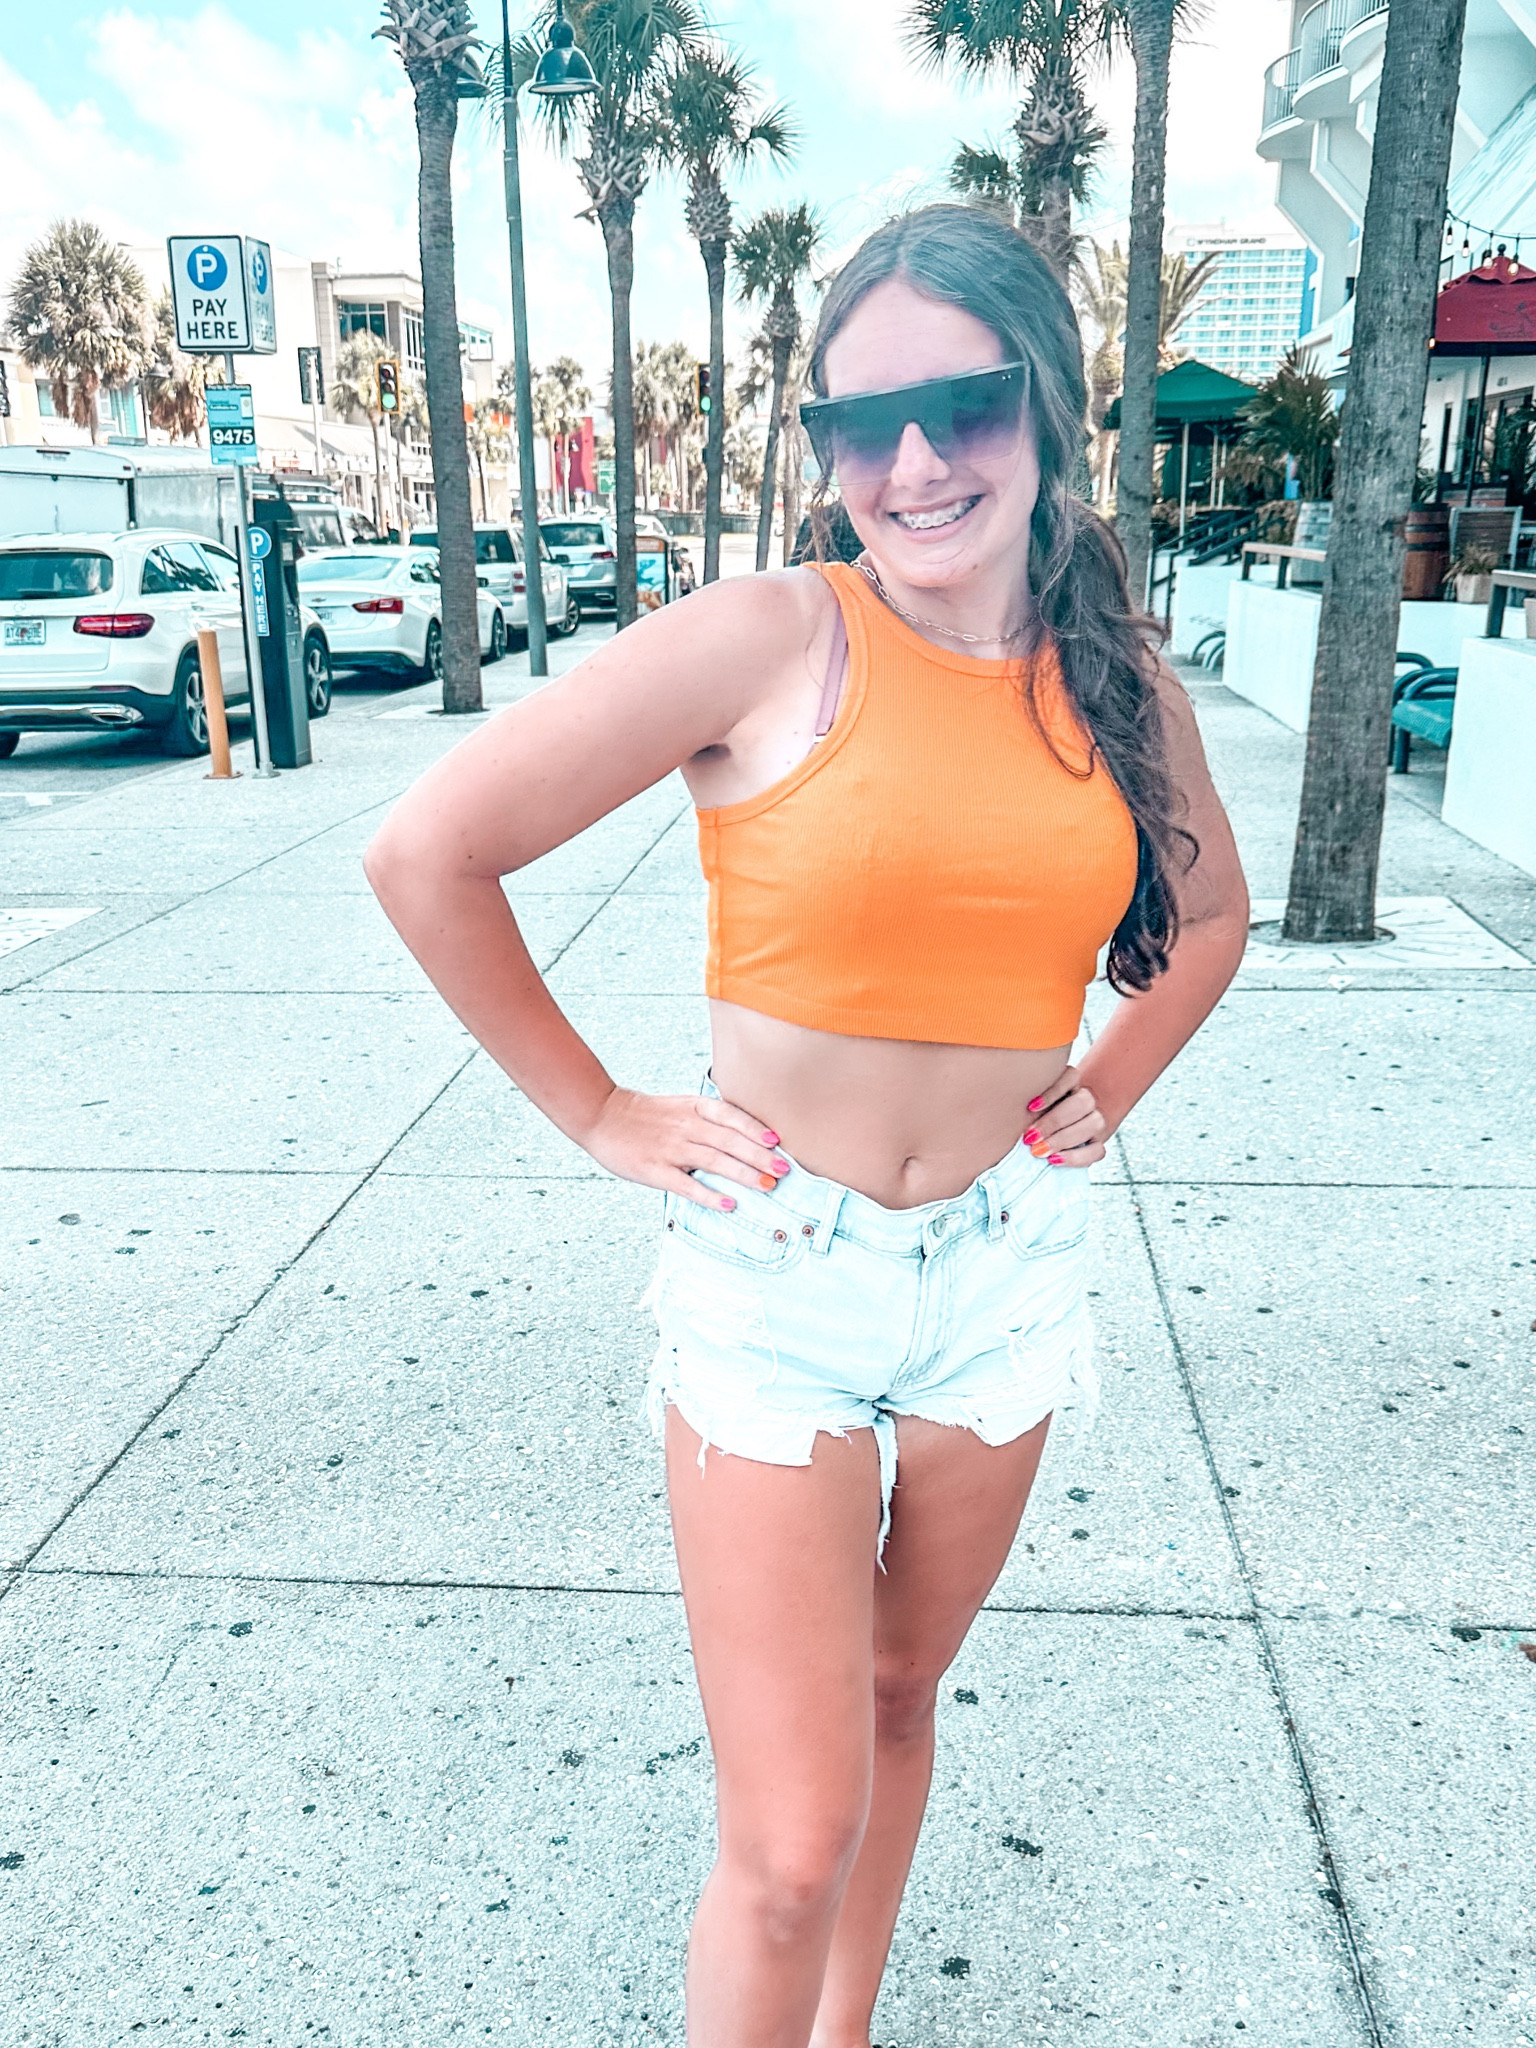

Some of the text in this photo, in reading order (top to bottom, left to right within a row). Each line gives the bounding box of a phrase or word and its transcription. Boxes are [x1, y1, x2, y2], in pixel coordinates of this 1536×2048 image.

[195, 253, 218, 283] P
[192, 299, 227, 317] PAY
[187, 321, 239, 340] HERE
[212, 429, 254, 445] 9475
[250, 532, 264, 555] P
[251, 563, 268, 633] PAY HERE
